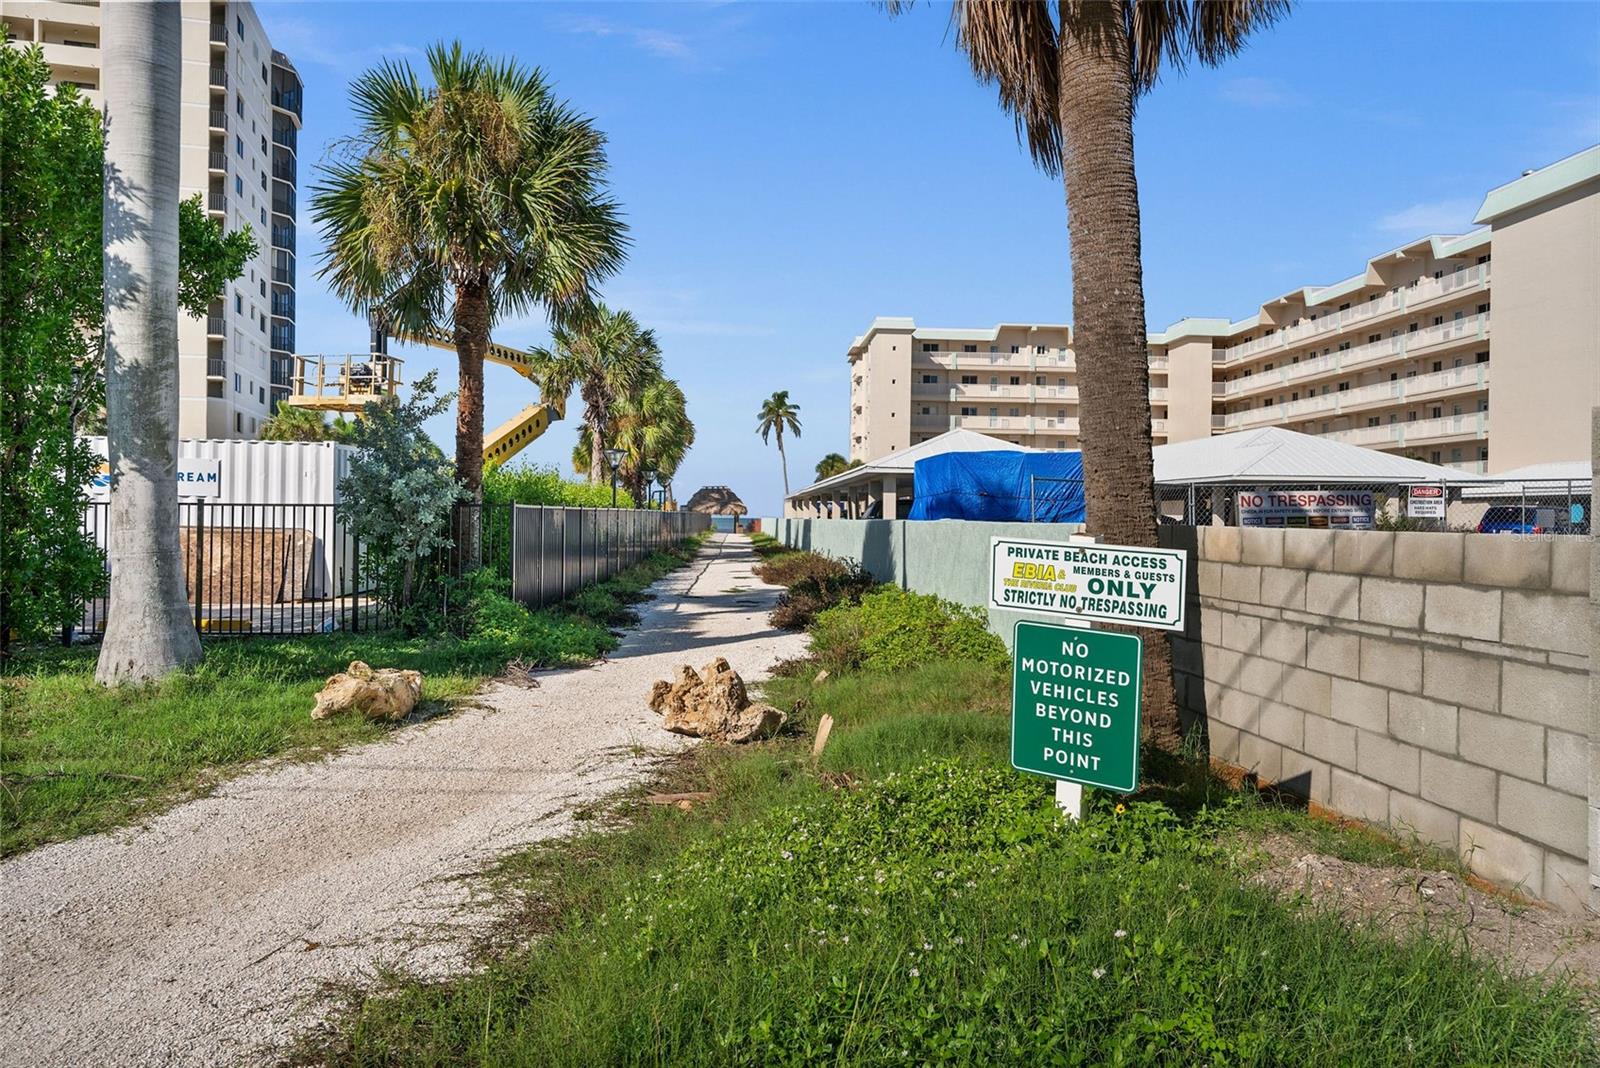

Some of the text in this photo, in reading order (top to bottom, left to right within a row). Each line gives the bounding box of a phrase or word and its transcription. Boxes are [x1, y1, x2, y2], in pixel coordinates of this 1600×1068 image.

[1241, 494, 1372, 507] NO TRESPASSING
[1008, 547, 1167, 569] PRIVATE BEACH ACCESS
[1012, 562, 1066, 582] EBIA &
[1073, 566, 1175, 582] MEMBERS & GUESTS
[1054, 583, 1077, 593] CLUB
[1087, 578, 1157, 599] ONLY
[1004, 589, 1167, 619] STRICTLY NO TRESPASSING
[1062, 641, 1089, 658] NO
[1022, 658, 1130, 686] MOTORIZED
[1030, 680, 1119, 707] VEHICLES
[1036, 703, 1111, 728] BEYOND
[1052, 727, 1093, 747] THIS
[1044, 747, 1101, 771] POINT
